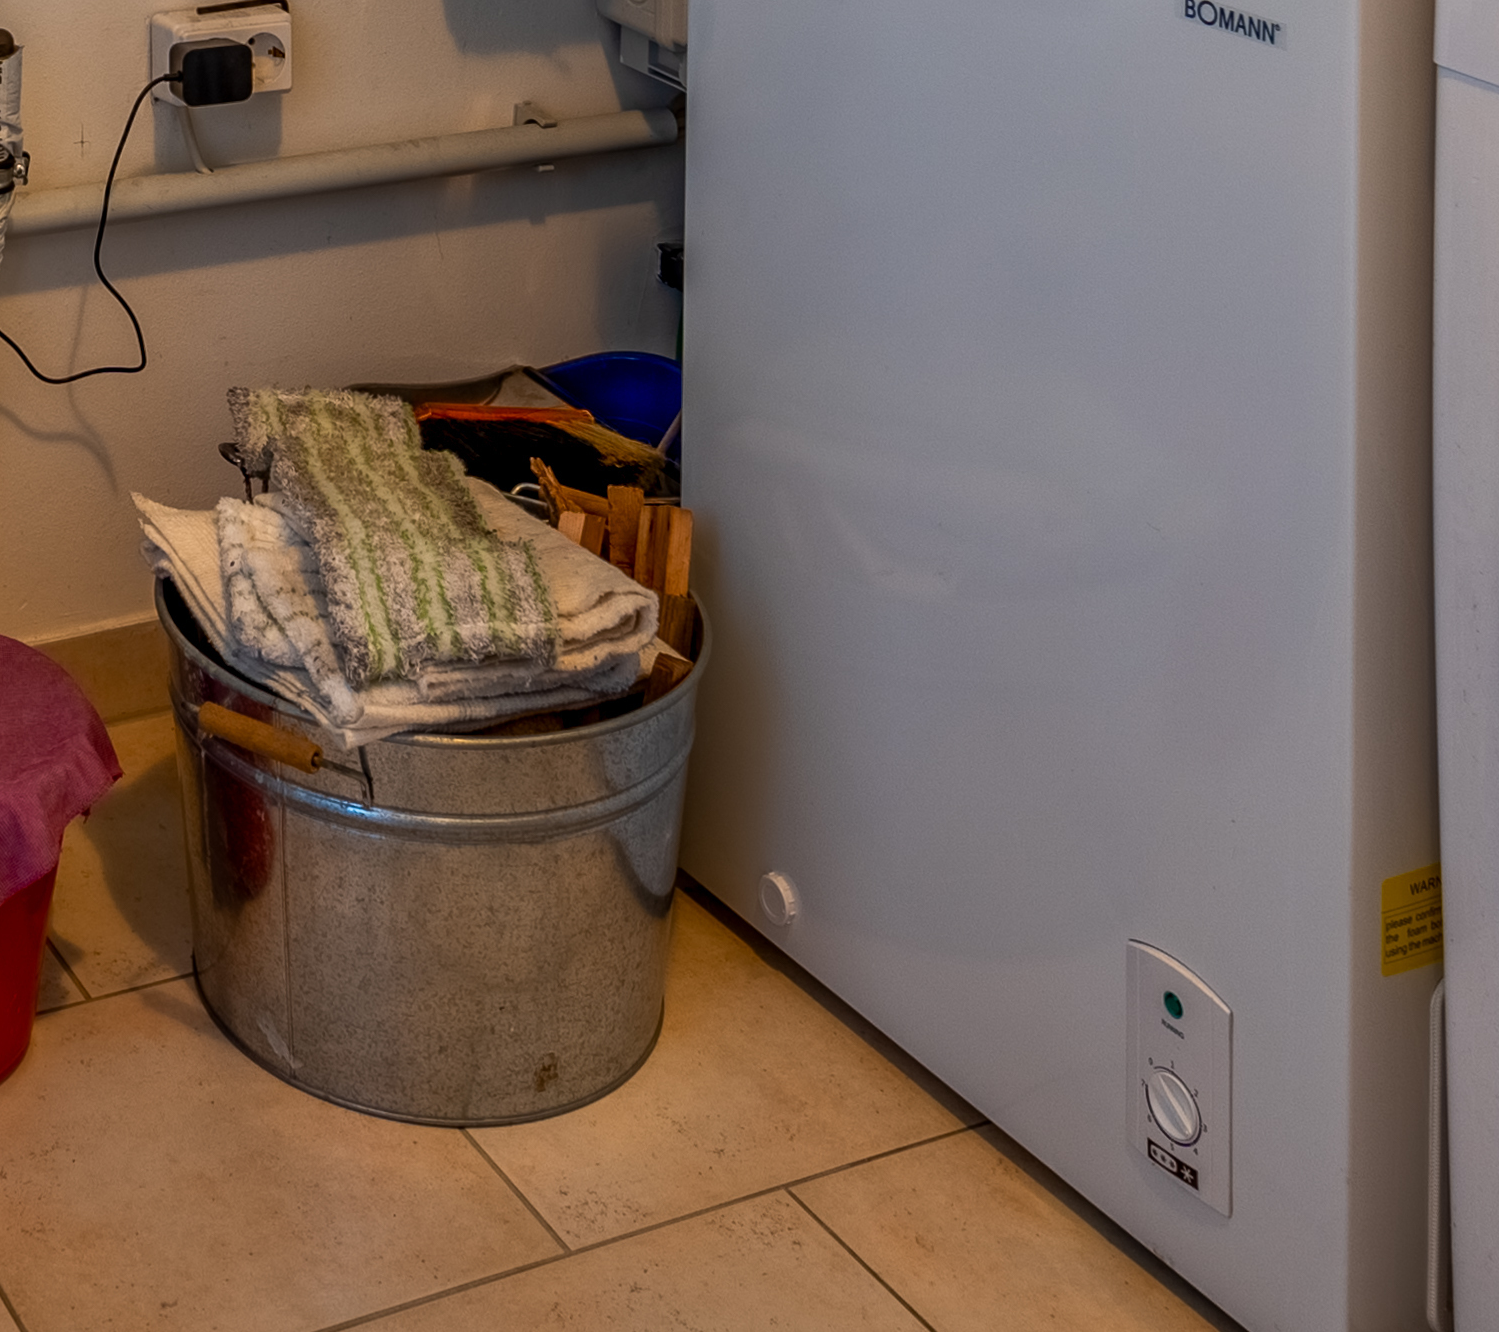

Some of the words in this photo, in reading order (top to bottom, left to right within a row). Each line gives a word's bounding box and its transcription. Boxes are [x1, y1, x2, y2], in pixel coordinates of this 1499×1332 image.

[1385, 916, 1413, 932] please
[1385, 934, 1399, 944] the
[1407, 925, 1428, 938] foam
[1385, 944, 1408, 958] using
[1408, 940, 1421, 951] the
